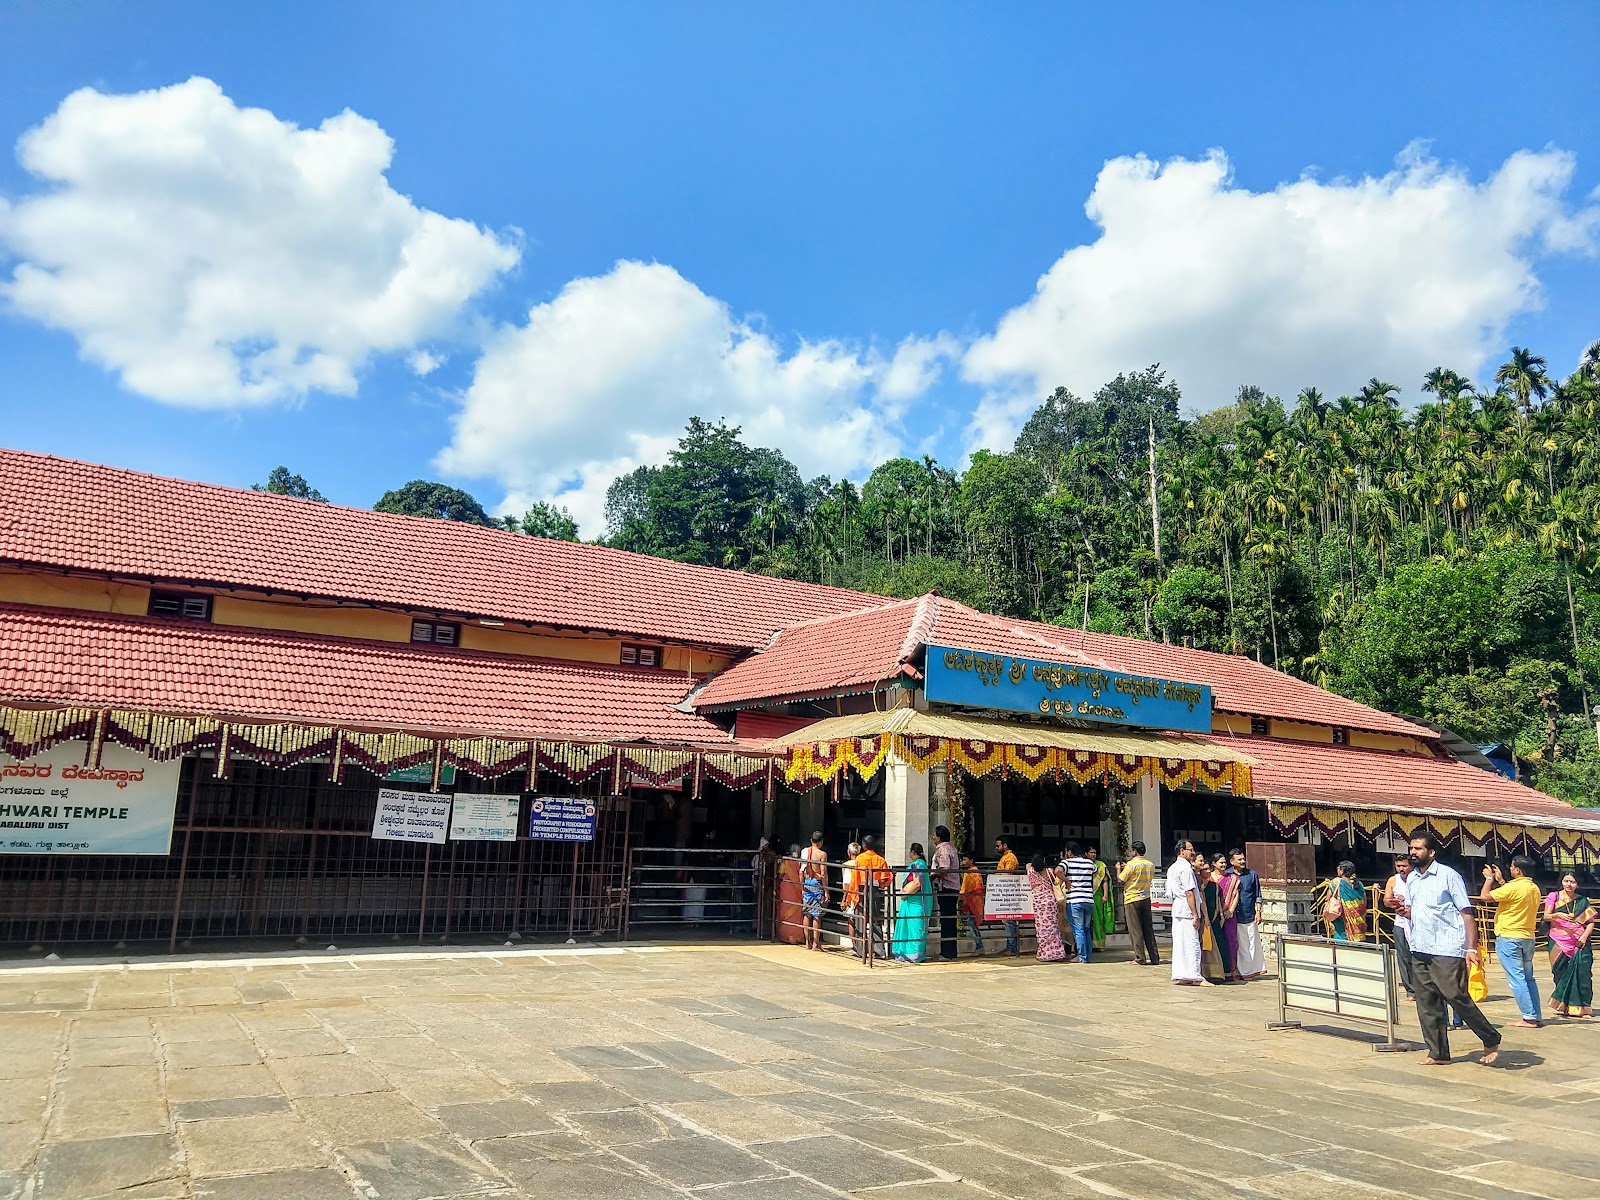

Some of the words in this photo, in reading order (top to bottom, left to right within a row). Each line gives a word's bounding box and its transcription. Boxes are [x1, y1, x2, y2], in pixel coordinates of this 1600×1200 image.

[1009, 656, 1027, 684] ಶ್ರೀ
[1114, 675, 1161, 705] ಅಮ್ಮನವರ
[1163, 680, 1202, 711] ದೇವಸ್ಥಾನ
[0, 762, 52, 782] ನವರ
[61, 764, 144, 789] ದೇವಸ್ಥಾನ
[51, 788, 69, 798] ಜಿಲ್ಲೆ
[381, 791, 399, 799] ಪರಿಸರ
[402, 793, 416, 804] ಮತ್ತು
[418, 795, 451, 804] ವಾತಾವರಣದ
[63, 806, 128, 819] TEMPLE
[383, 803, 405, 815] ಸಂರಕ್ಷಣೆ
[0, 821, 44, 829] AGALURU
[407, 818, 444, 830] ವಾತಾವರಣದಲ್ಲಿ
